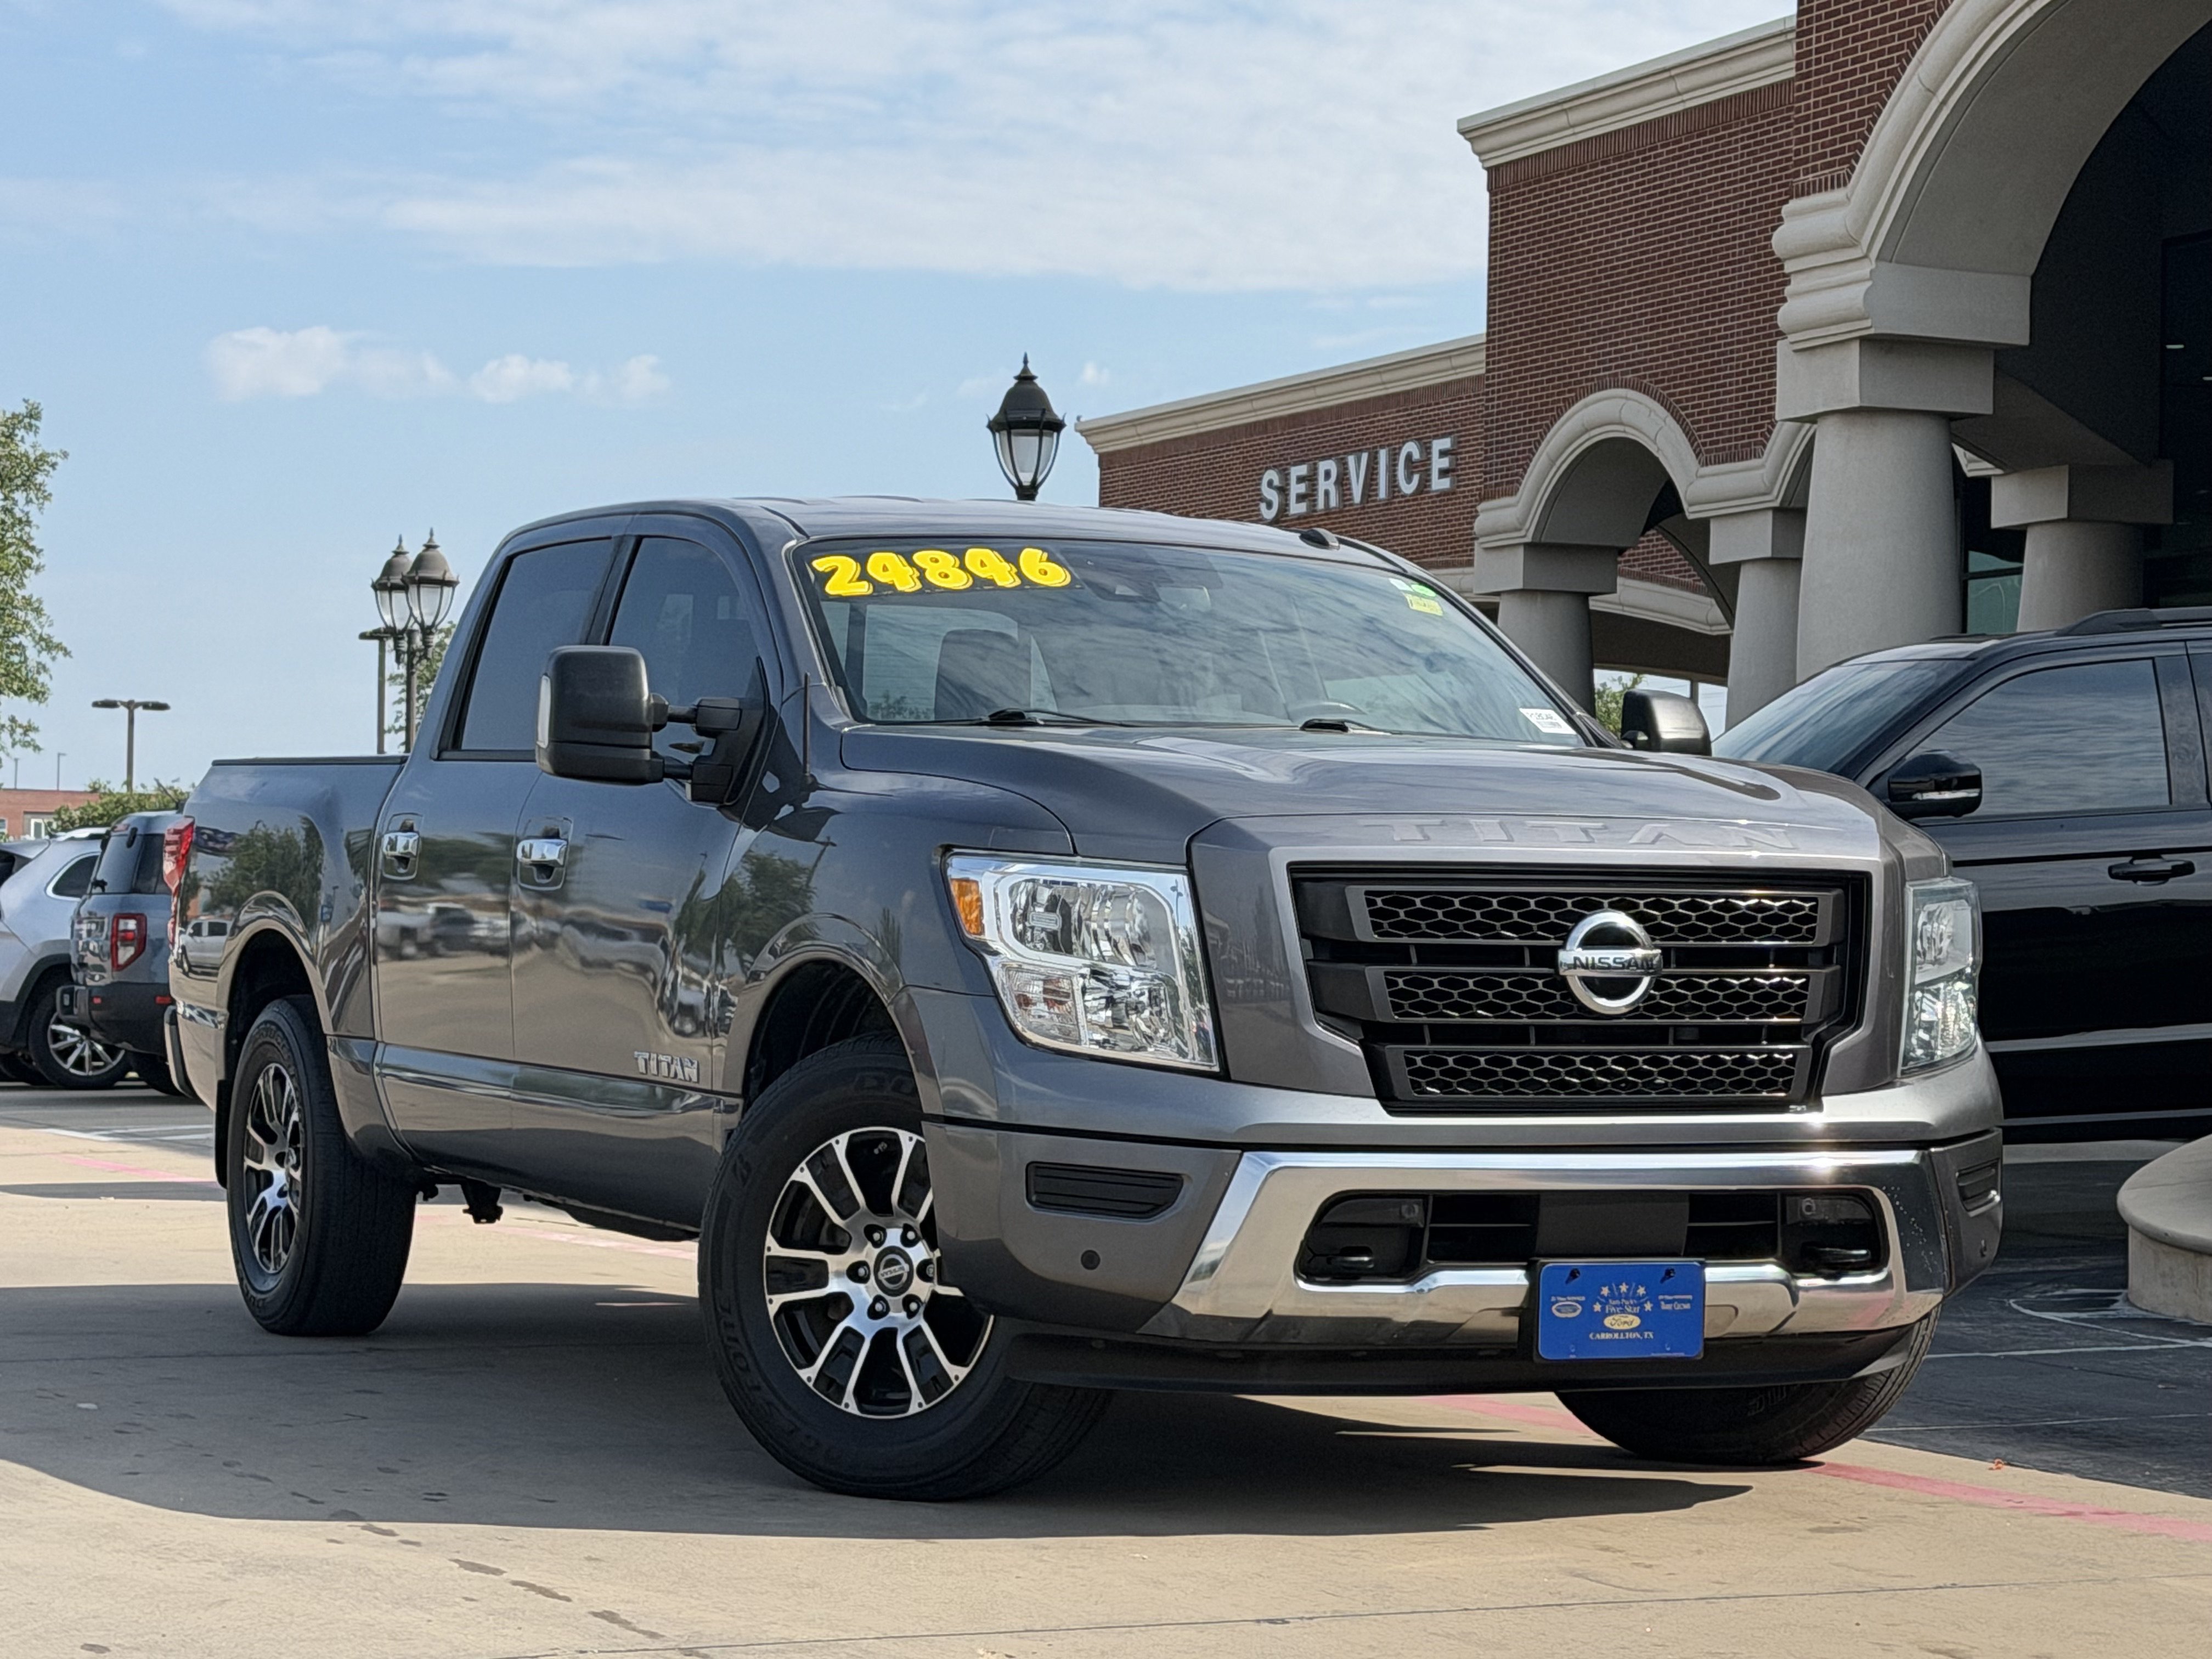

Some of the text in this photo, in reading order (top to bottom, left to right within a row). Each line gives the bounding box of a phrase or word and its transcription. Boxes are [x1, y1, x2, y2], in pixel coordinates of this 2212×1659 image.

[1260, 437, 1455, 521] SERVICE
[811, 548, 1071, 596] 24846
[1360, 819, 1795, 848] TITAN
[1573, 956, 1654, 972] NISSAN
[634, 1051, 699, 1082] TITAN
[1610, 1317, 1635, 1327] Ford
